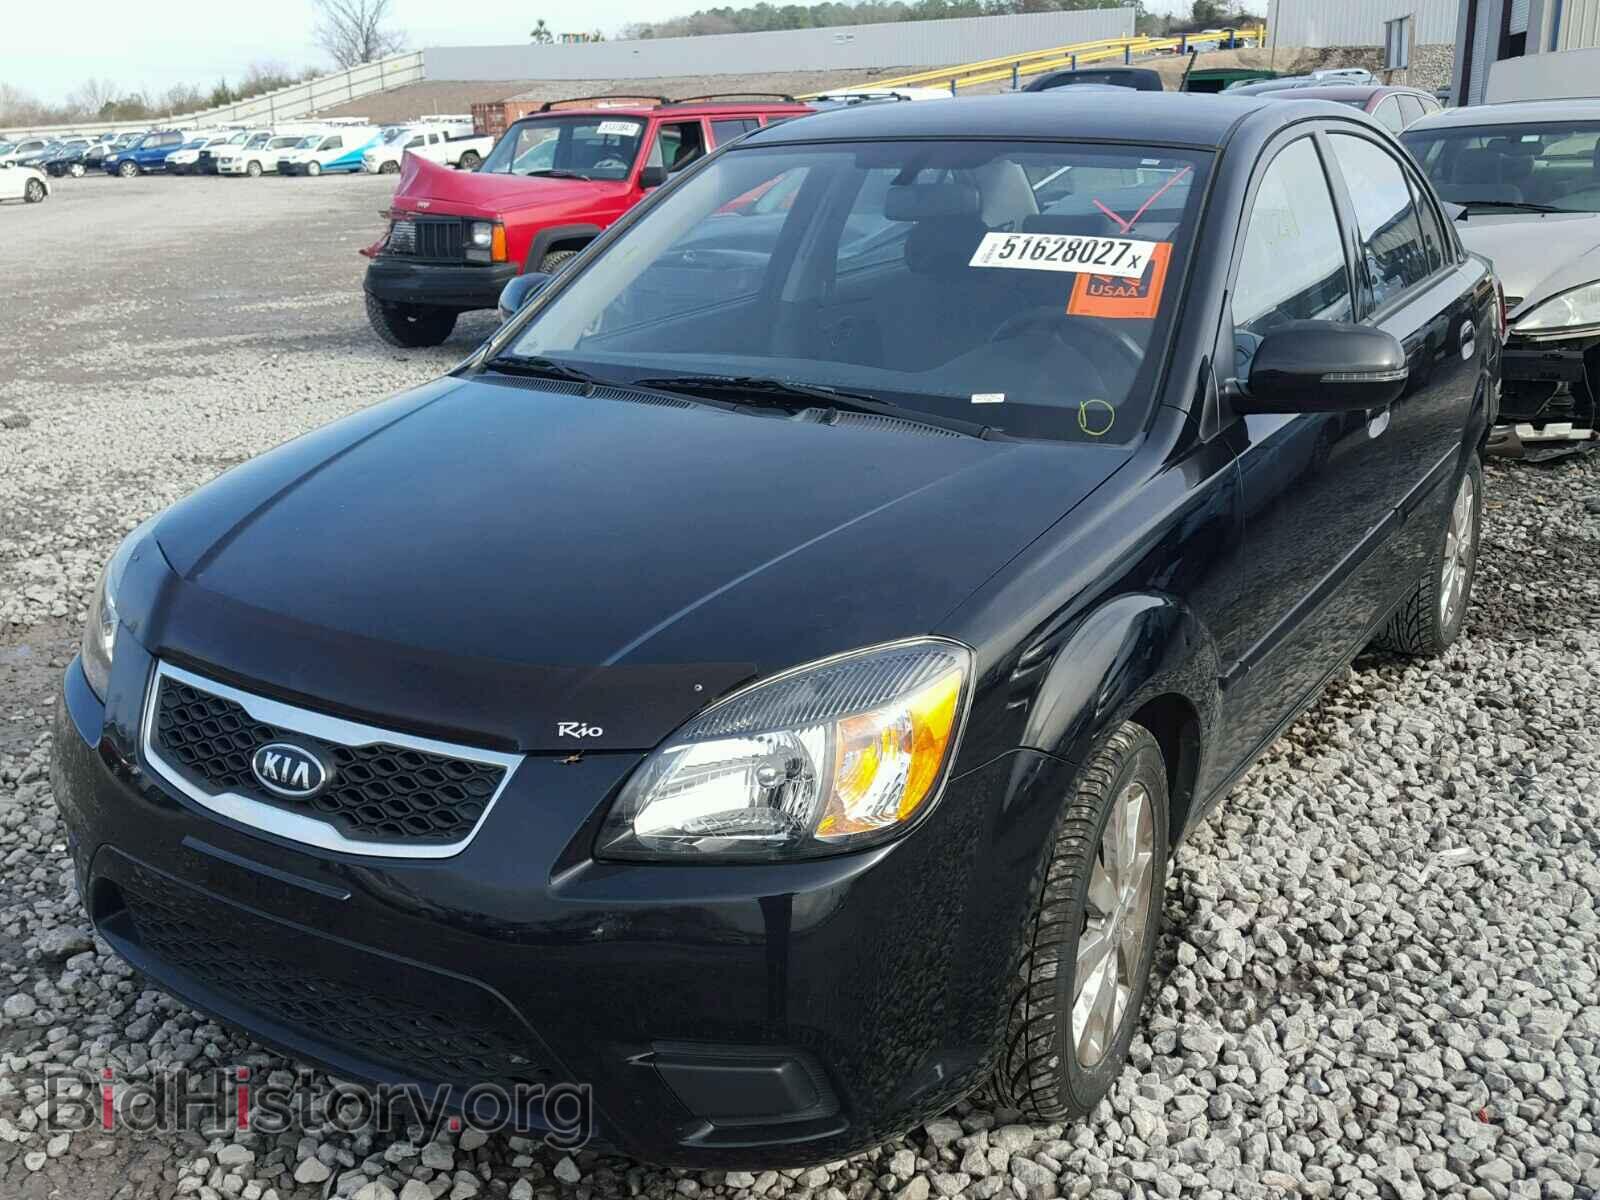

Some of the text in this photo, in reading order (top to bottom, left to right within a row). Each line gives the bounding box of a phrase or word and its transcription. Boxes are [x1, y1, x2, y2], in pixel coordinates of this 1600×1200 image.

[999, 235, 1132, 267] 51628027
[1090, 284, 1138, 297] USAA
[557, 722, 603, 738] Rio
[262, 751, 310, 789] KIA
